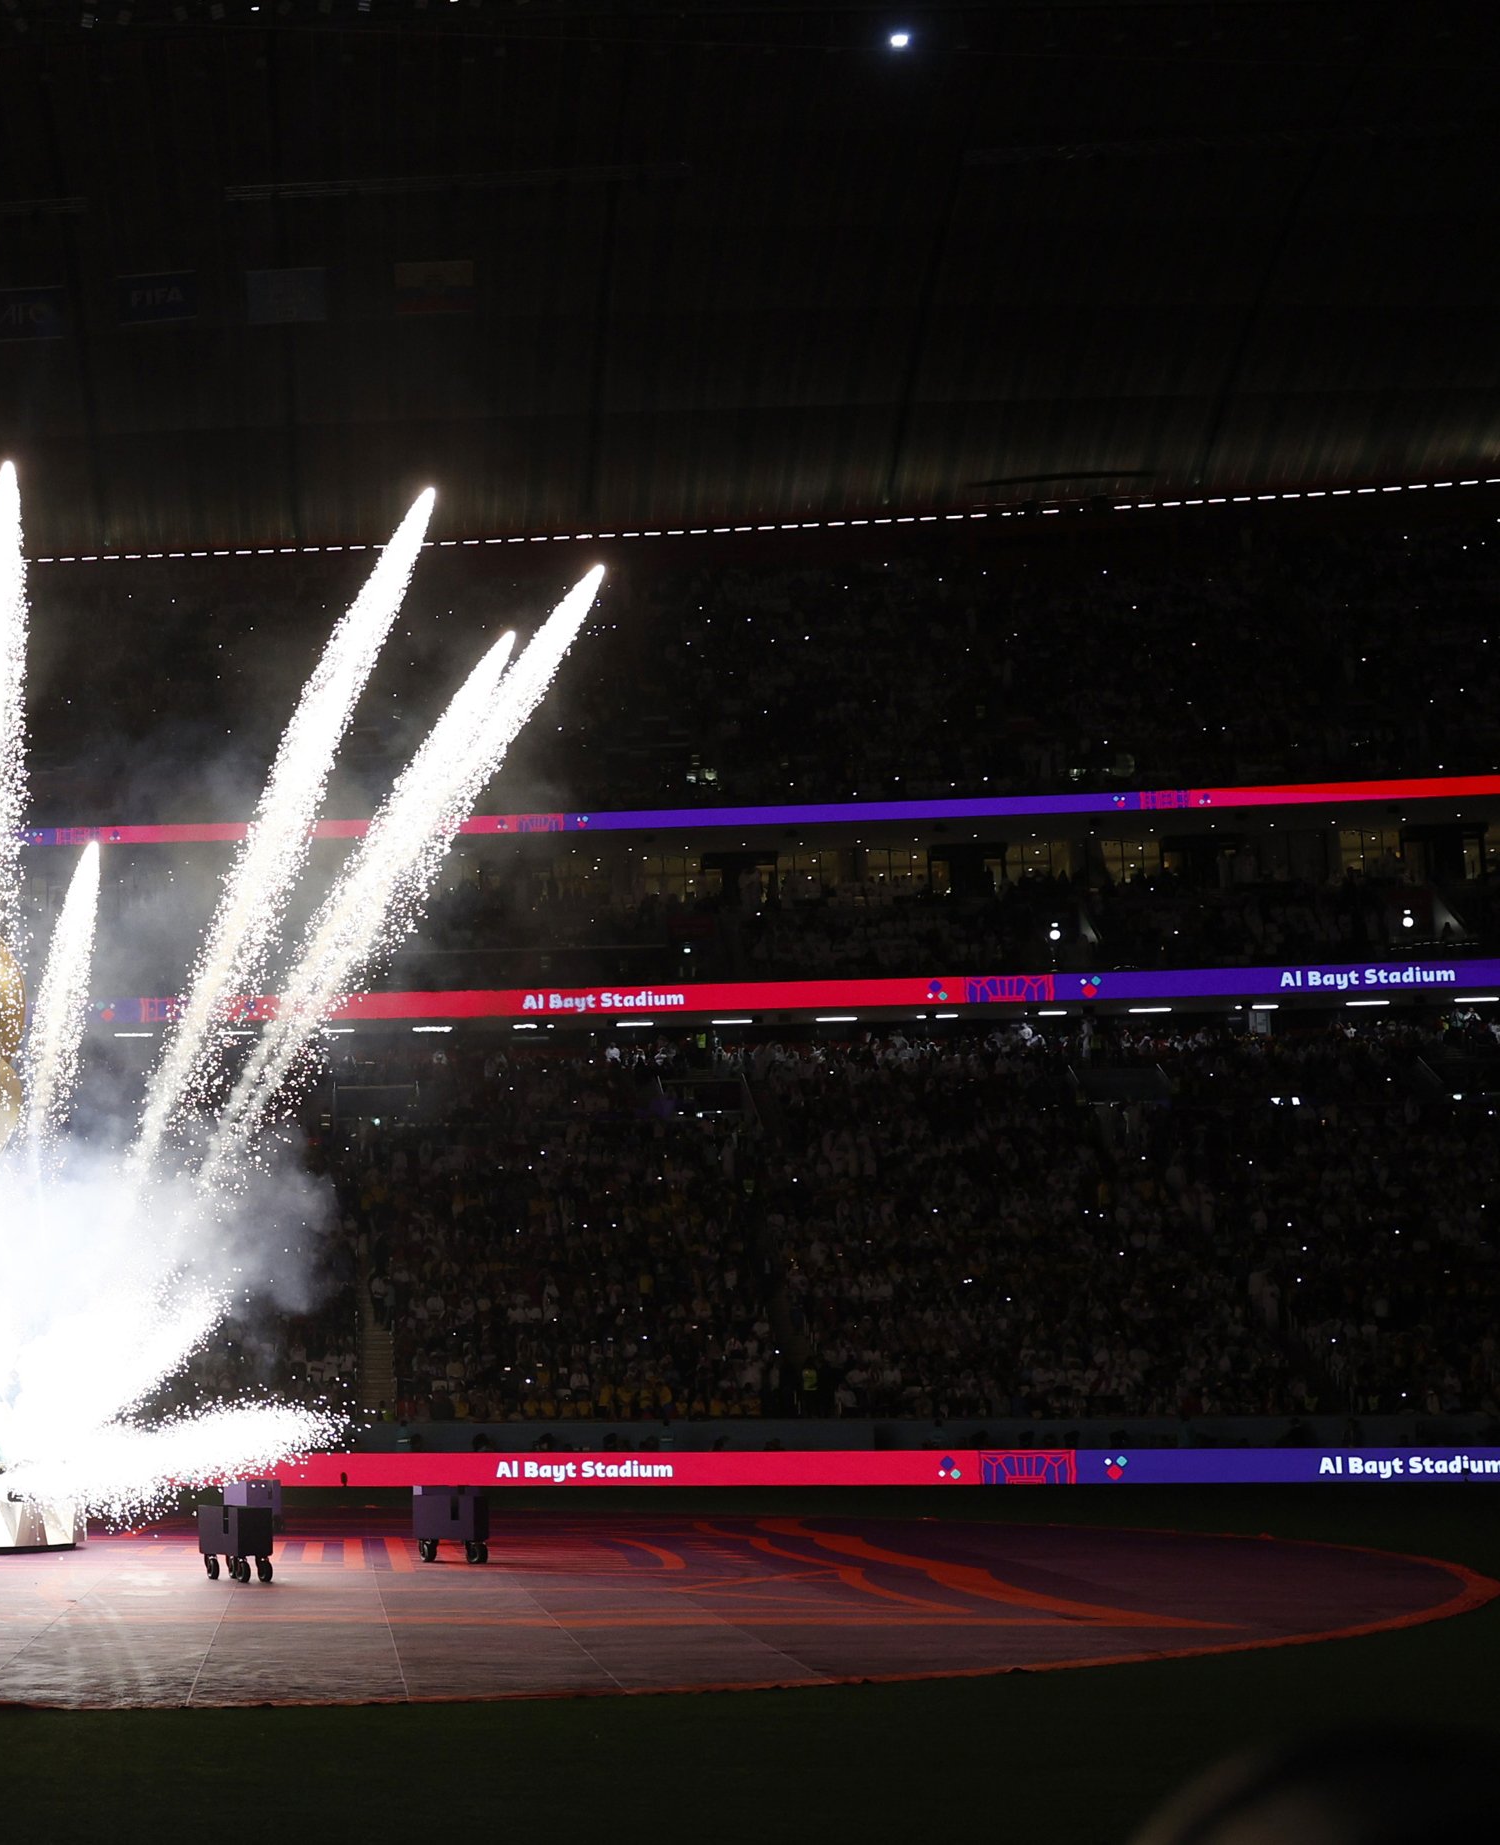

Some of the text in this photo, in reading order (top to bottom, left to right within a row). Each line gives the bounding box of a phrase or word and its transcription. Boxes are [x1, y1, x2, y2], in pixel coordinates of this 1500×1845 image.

[131, 286, 184, 307] FIFA
[1280, 967, 1456, 989] Al Bayt Stadium
[522, 991, 685, 1013] Al Bayt Stadium
[496, 1460, 673, 1482] Al Bayt Stadium
[1319, 1456, 1343, 1474] Al
[1348, 1456, 1404, 1479] Bayt
